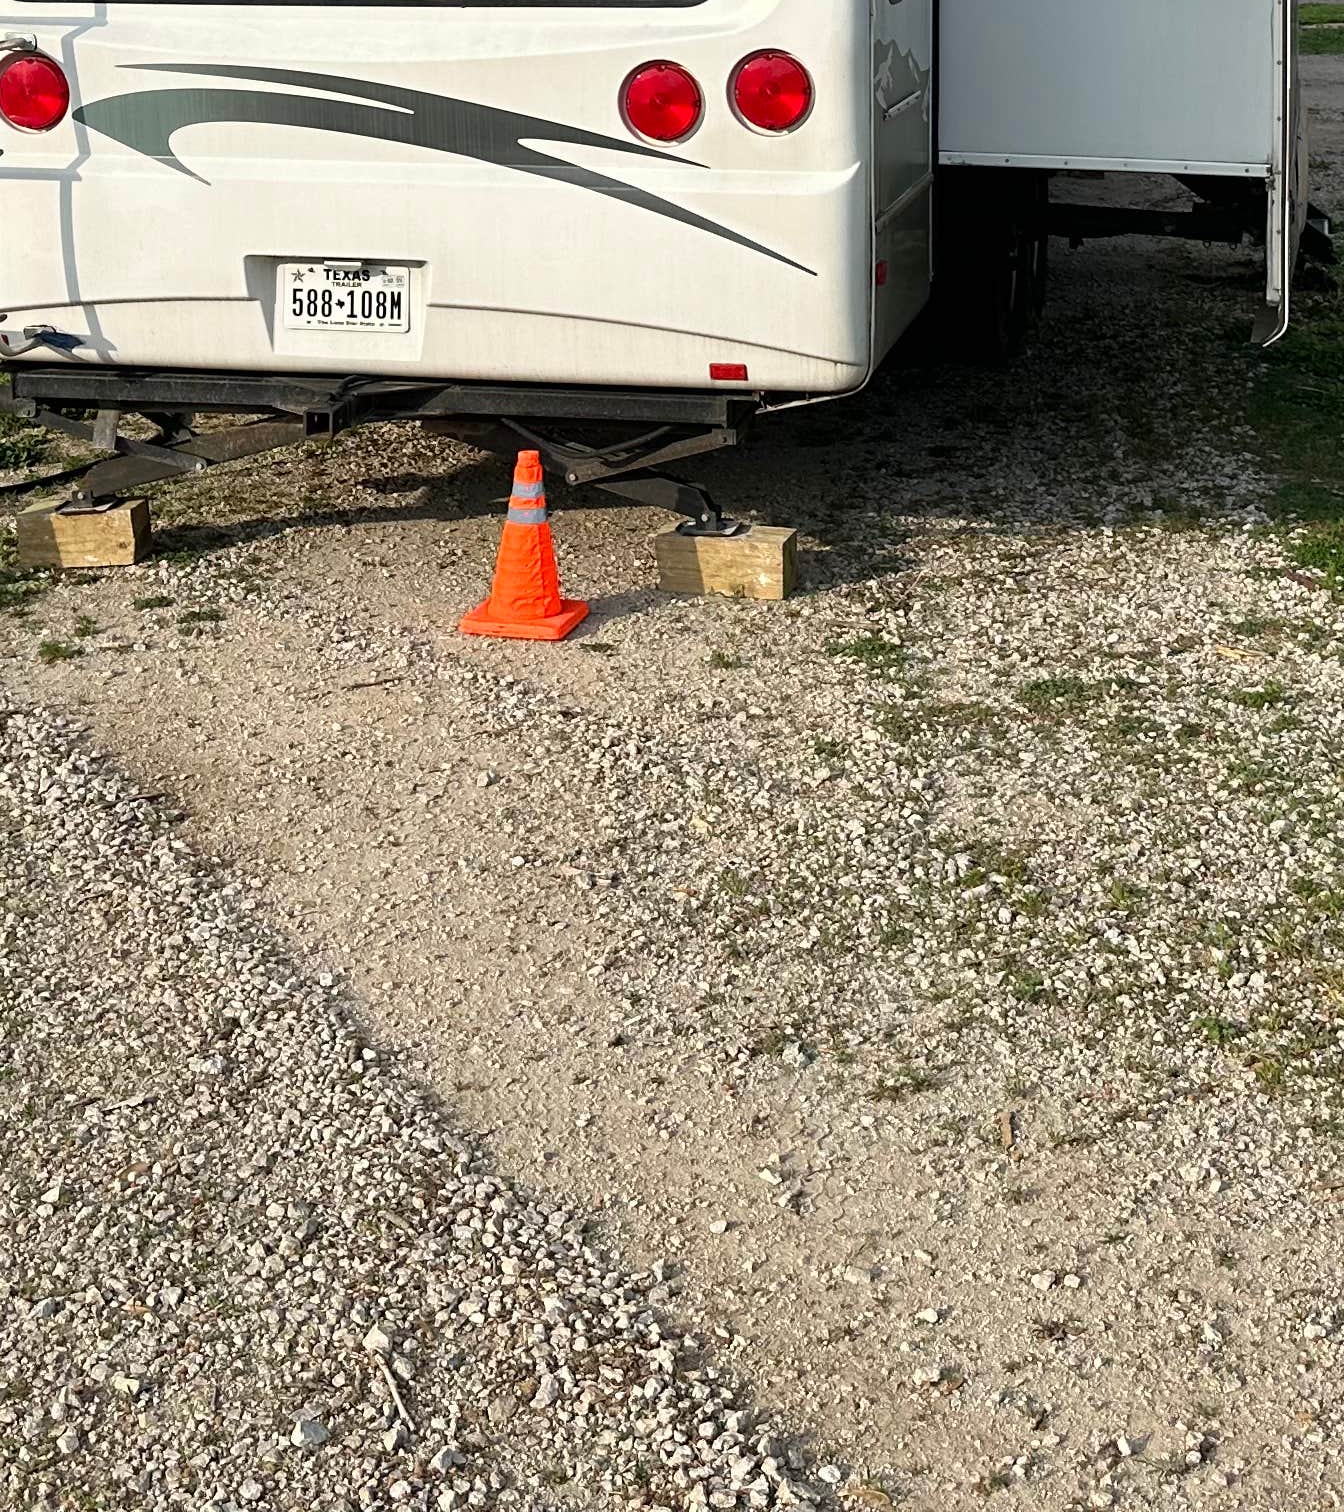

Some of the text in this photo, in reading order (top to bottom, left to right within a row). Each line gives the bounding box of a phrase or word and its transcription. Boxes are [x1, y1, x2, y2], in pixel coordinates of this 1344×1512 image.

[323, 268, 370, 281] TEXAS
[292, 288, 401, 320] 588 108M
